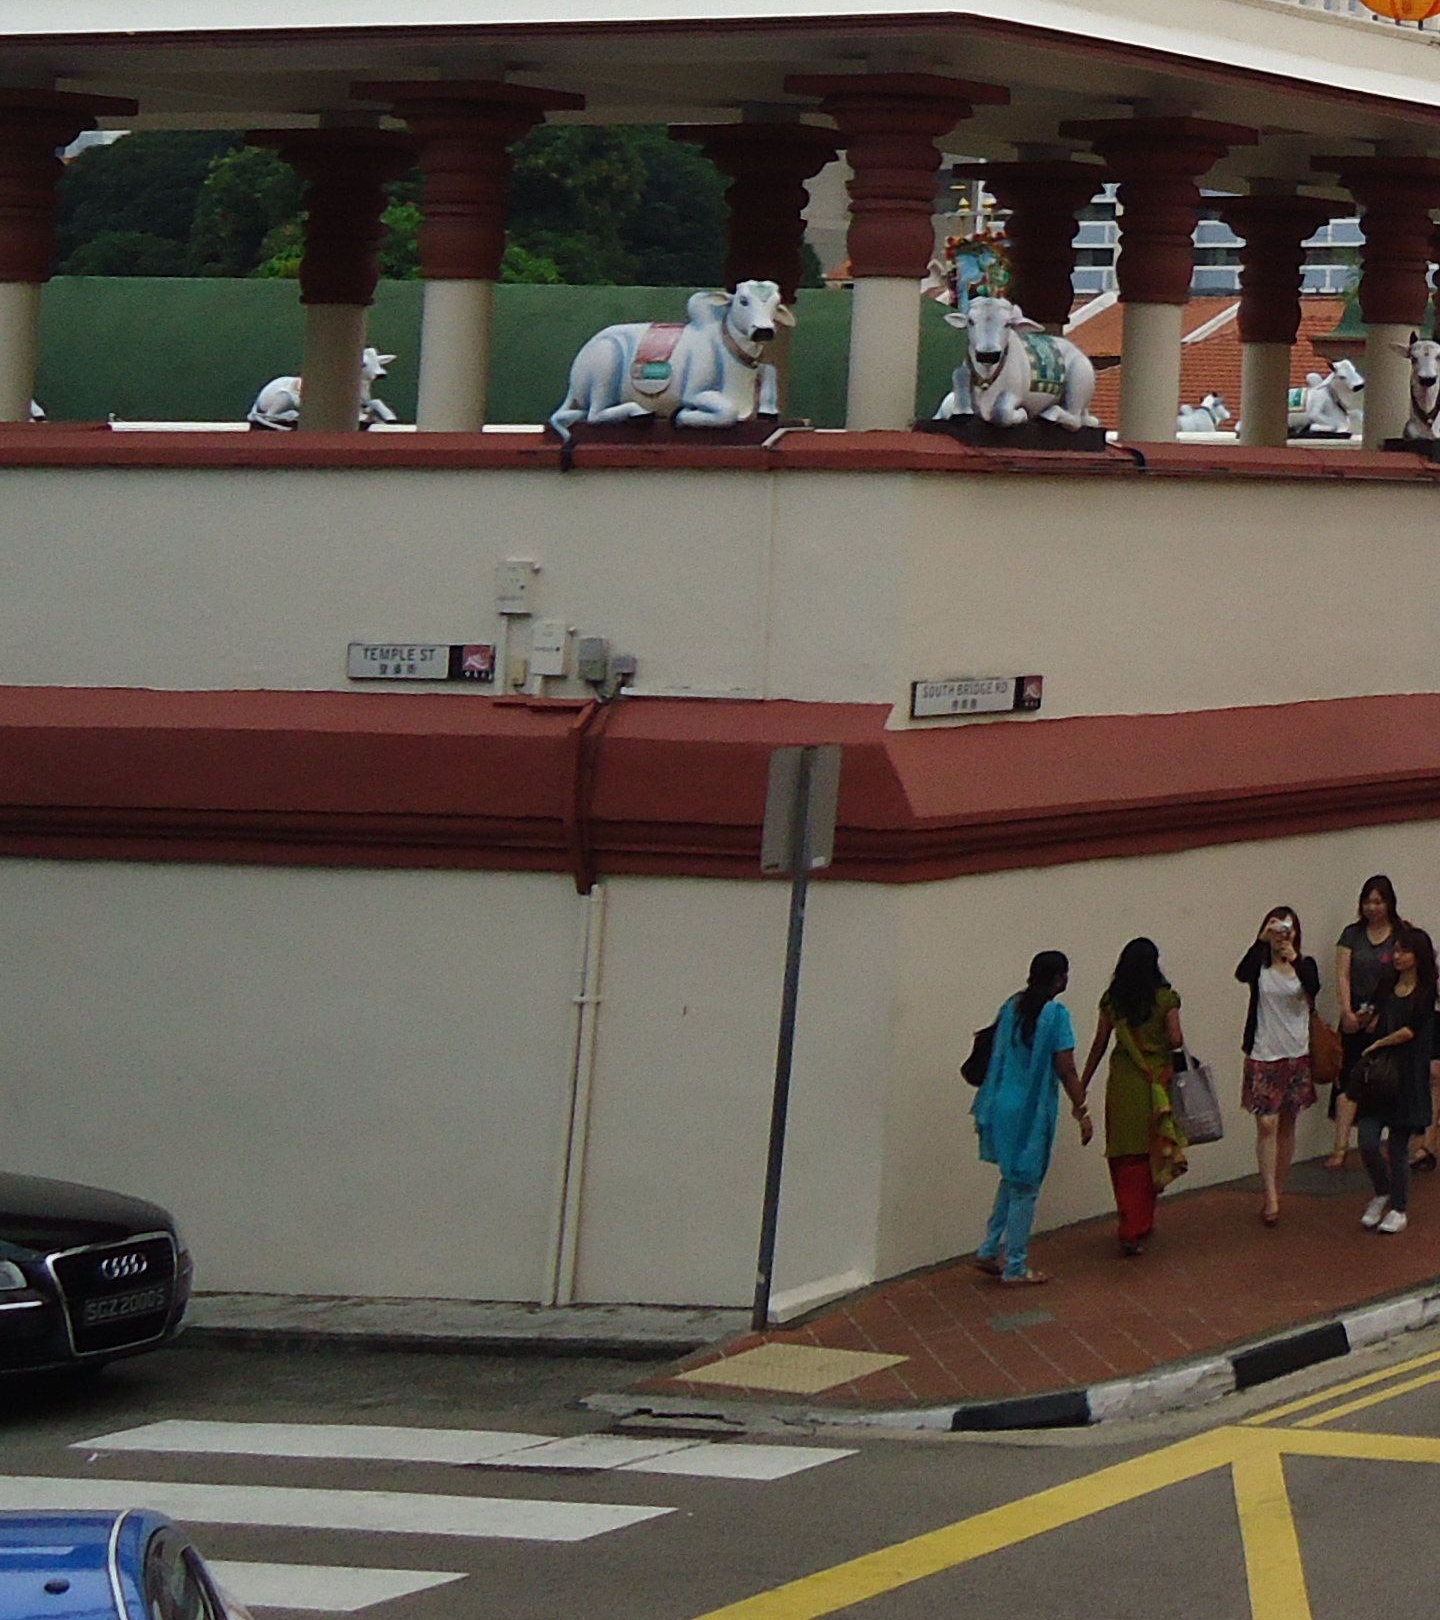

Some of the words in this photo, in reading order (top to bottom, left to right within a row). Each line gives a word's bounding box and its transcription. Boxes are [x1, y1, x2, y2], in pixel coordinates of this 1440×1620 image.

[362, 647, 416, 661] TEMPLE
[419, 648, 436, 661] ST
[922, 684, 955, 699] SOUTH
[956, 681, 993, 696] BRIDGE
[995, 681, 1008, 694] RD
[87, 1287, 166, 1321] SGZ2000S
